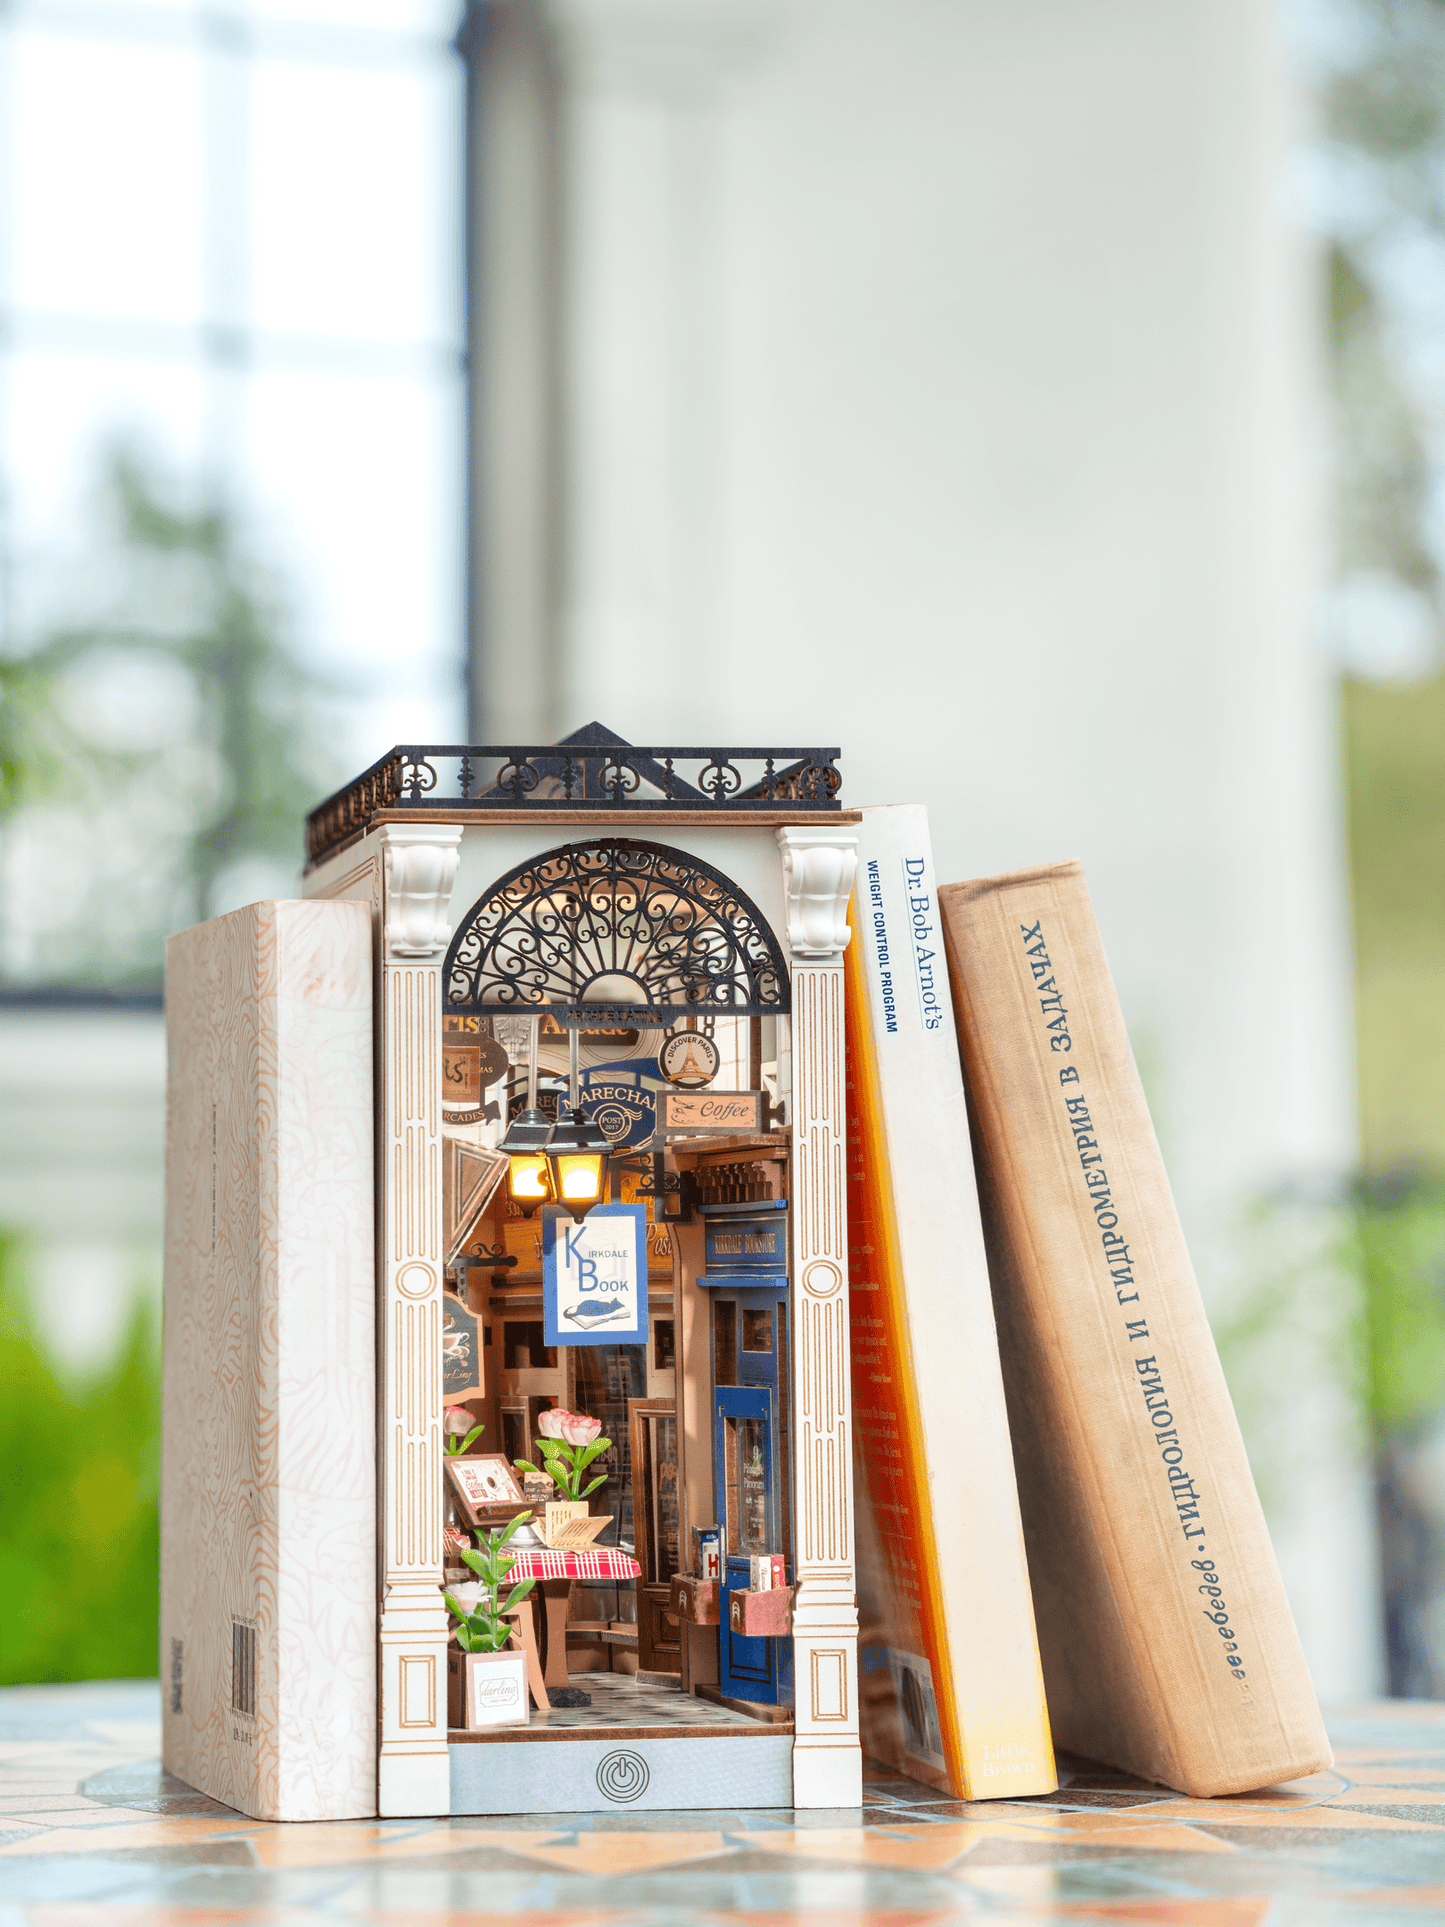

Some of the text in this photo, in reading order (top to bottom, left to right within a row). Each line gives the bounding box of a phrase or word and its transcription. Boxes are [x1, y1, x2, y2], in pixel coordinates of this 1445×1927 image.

[867, 860, 898, 1033] WEIGHT CONTROL PROGRAM
[905, 857, 943, 1030] Dr. Bob Arnot's
[1020, 919, 1072, 1052] ЗАДАЧАХ
[667, 1036, 714, 1059] DISCOVER PARIS
[1059, 1066, 1080, 1087] В
[700, 1101, 749, 1121] Coffee
[1065, 1094, 1140, 1306] ГИДРОМЕТРИЯ
[565, 1226, 629, 1268] KIRKDALE
[578, 1258, 630, 1293] BOOK
[1125, 1318, 1150, 1342] И
[1135, 1355, 1206, 1541] ГИДРОЛОГИЯ
[481, 1680, 517, 1701] darling
[983, 1741, 1033, 1760] Little,
[981, 1762, 1035, 1777] Brown
